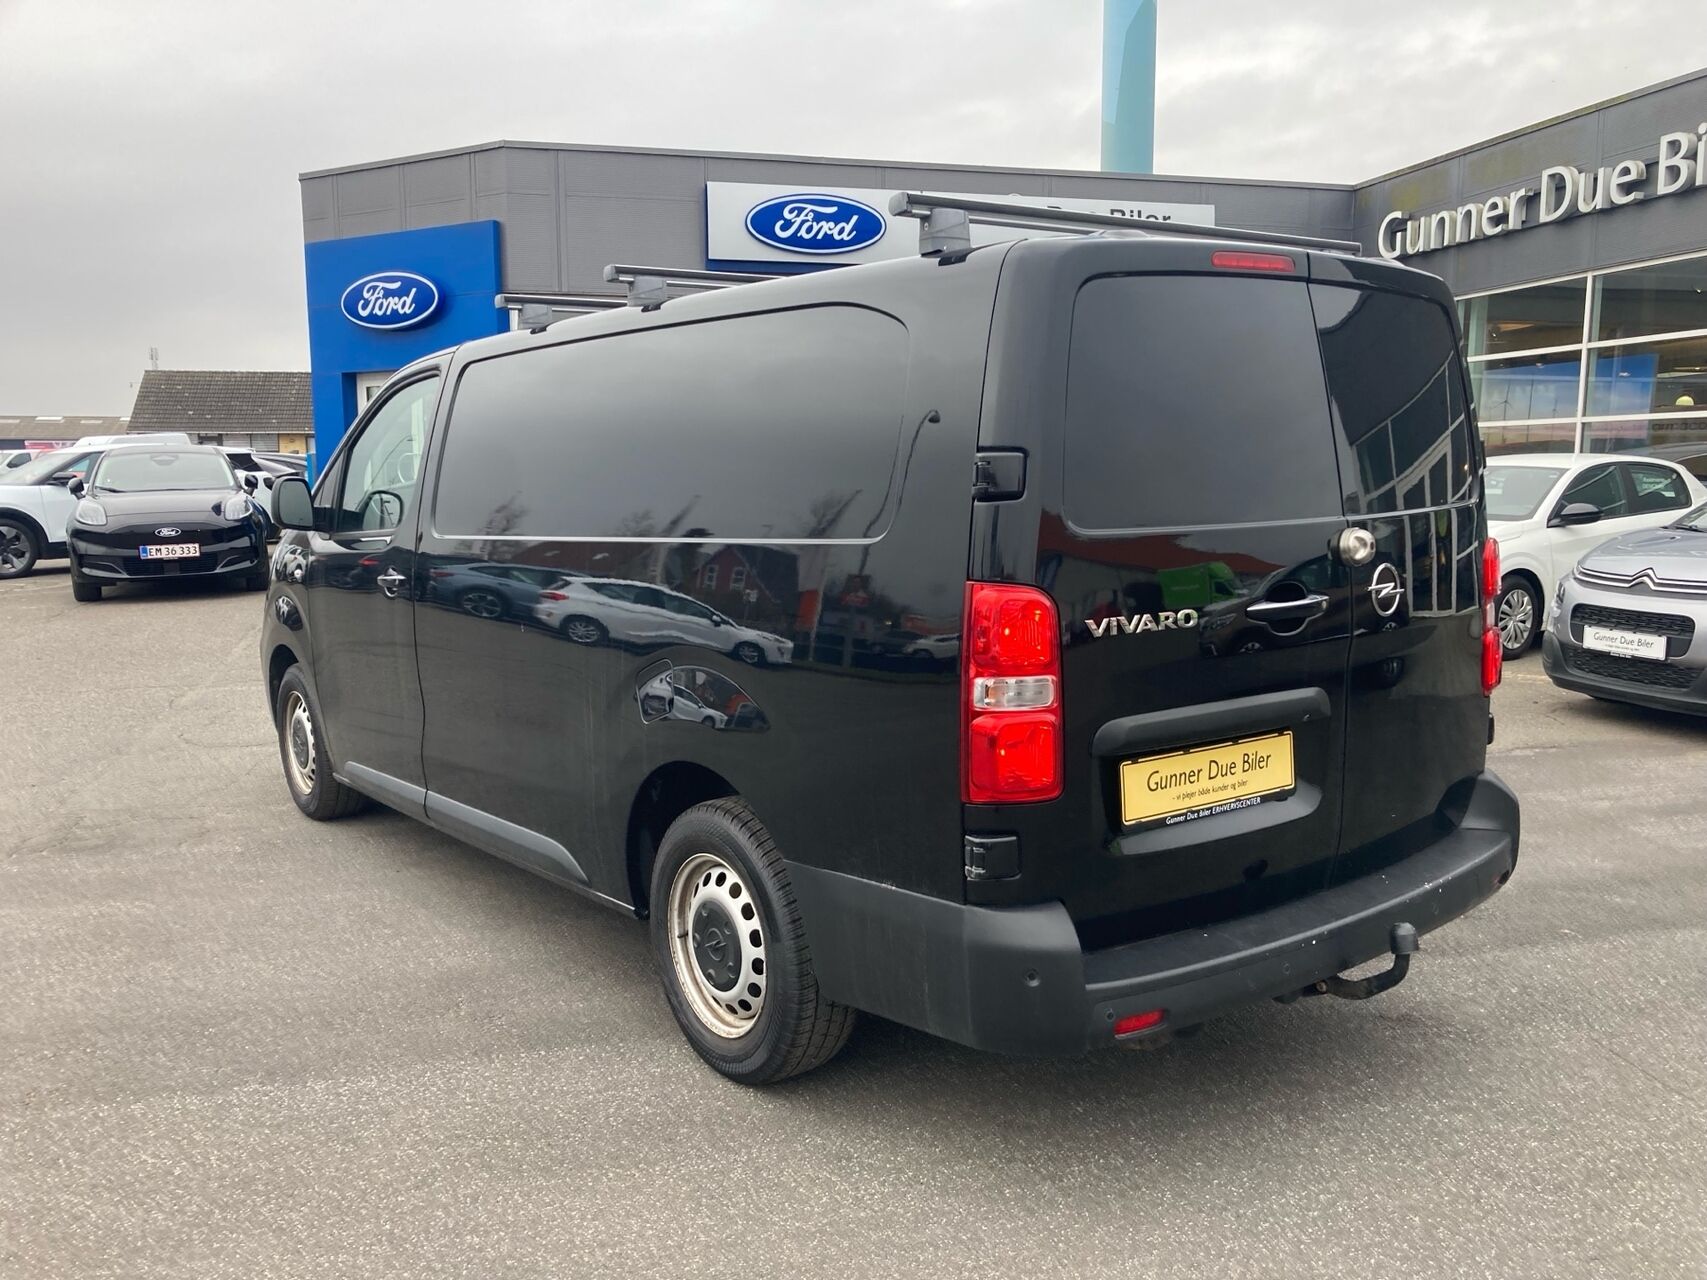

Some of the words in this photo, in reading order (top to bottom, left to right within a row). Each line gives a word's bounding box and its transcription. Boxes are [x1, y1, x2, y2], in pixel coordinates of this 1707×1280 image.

[774, 203, 859, 241] Ford
[1378, 188, 1535, 259] Gunner
[1539, 160, 1646, 224] Due
[357, 281, 417, 317] Ford
[149, 547, 162, 557] EM
[164, 546, 177, 556] 36
[179, 545, 198, 555] 333
[1084, 608, 1198, 638] VIVARO
[1593, 632, 1618, 643] Gunner
[1619, 635, 1635, 646] Due
[1637, 638, 1655, 648] Biler
[1147, 768, 1203, 792] Gunner
[1208, 759, 1237, 781] Due
[1242, 751, 1272, 773] Biler
[1212, 783, 1229, 793] kunder
[1165, 815, 1186, 825] Gunner
[1187, 811, 1198, 820] Due
